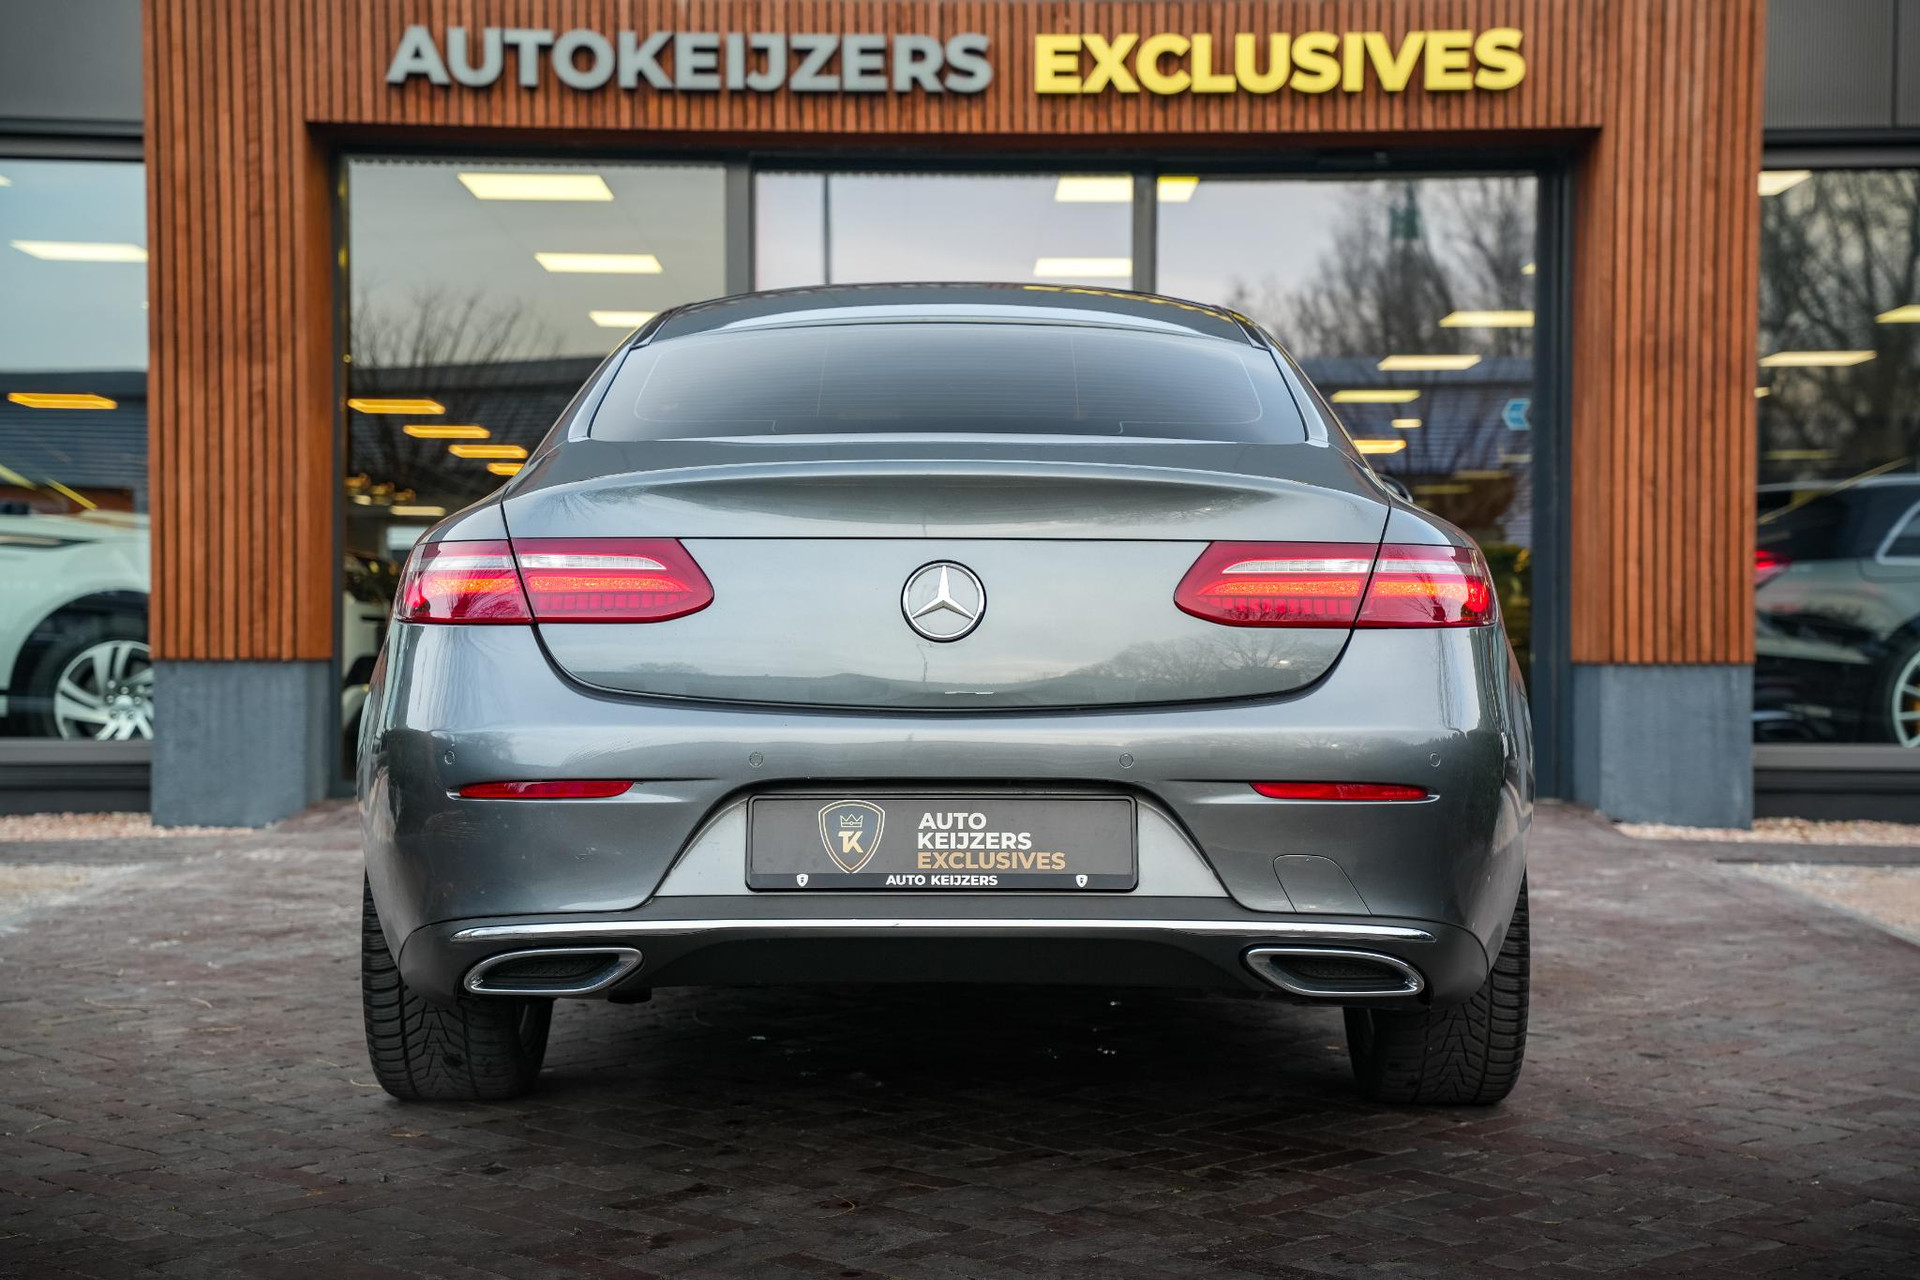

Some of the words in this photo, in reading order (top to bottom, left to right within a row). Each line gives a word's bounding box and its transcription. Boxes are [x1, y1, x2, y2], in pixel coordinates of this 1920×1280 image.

[386, 25, 994, 94] AUTOKEIJZERS
[1034, 27, 1527, 95] EXCLUSIVES
[917, 812, 987, 830] AUTO
[917, 832, 1032, 850] KEIJZERS
[917, 851, 1066, 870] EXCLUSIVES
[885, 874, 926, 886] AUTO
[931, 874, 998, 886] KEIJZERS
